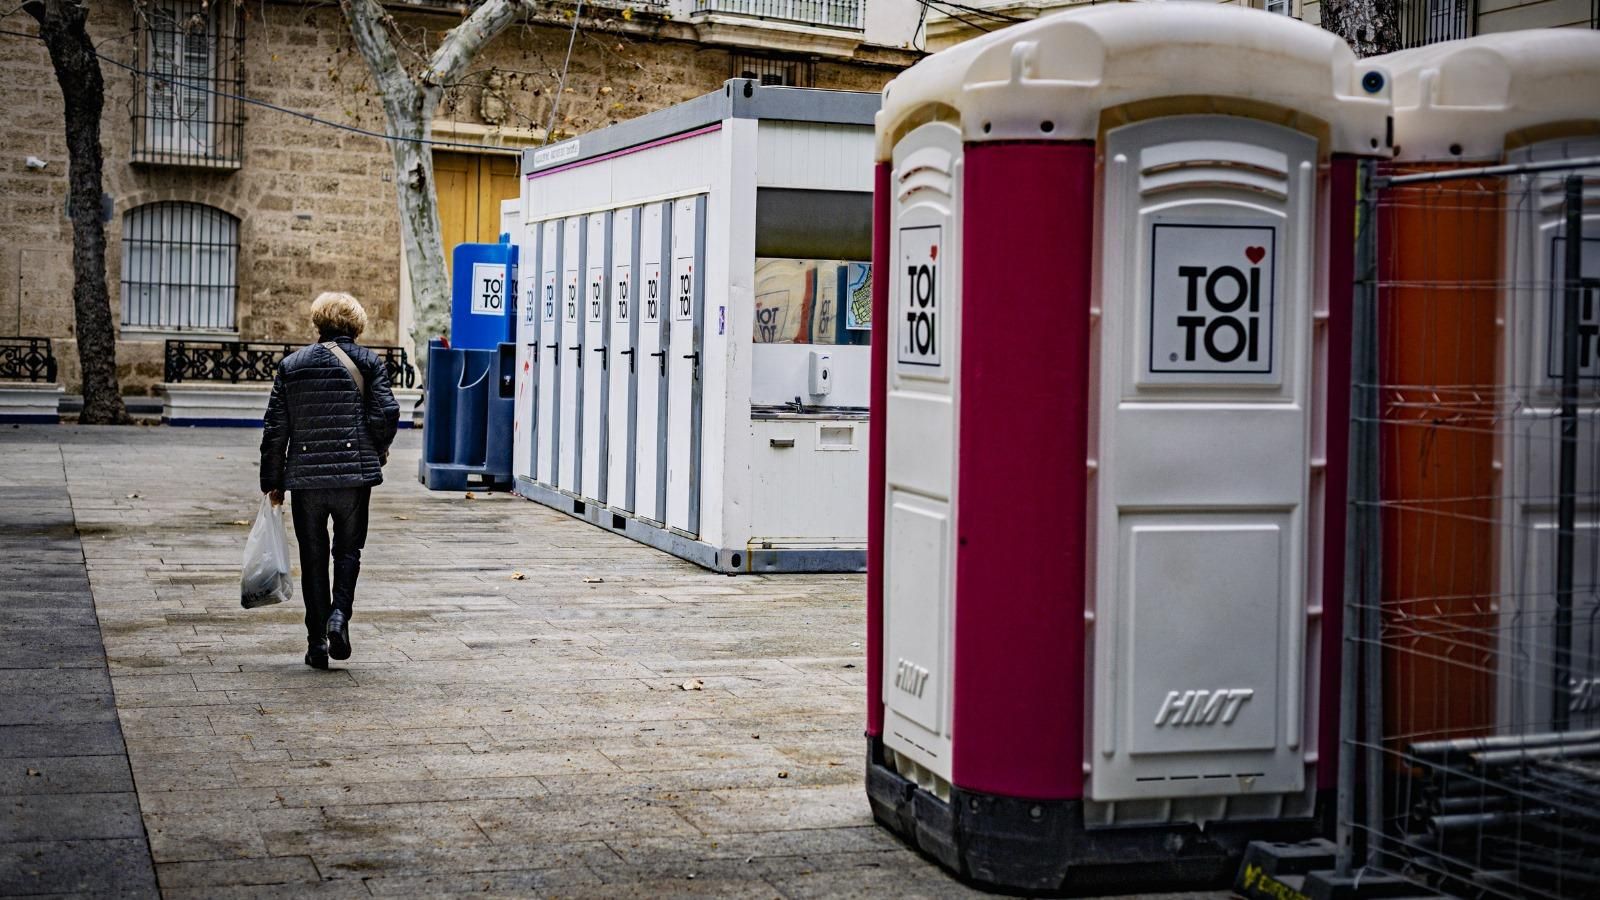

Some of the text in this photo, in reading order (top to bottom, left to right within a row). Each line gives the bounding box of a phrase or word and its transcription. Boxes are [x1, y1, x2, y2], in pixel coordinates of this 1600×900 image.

[483, 279, 503, 294] TOI
[648, 279, 658, 299] TOI
[680, 274, 691, 295] TOI
[908, 264, 935, 308] TOI
[1178, 265, 1260, 313] TOI
[482, 294, 503, 309] TOI
[619, 300, 628, 319] TOI
[647, 299, 658, 319] TOI
[680, 295, 691, 316] TOI
[907, 311, 935, 356] TOI
[1177, 315, 1259, 363] TOI
[895, 658, 929, 700] HMT
[1154, 688, 1254, 727] HMT
